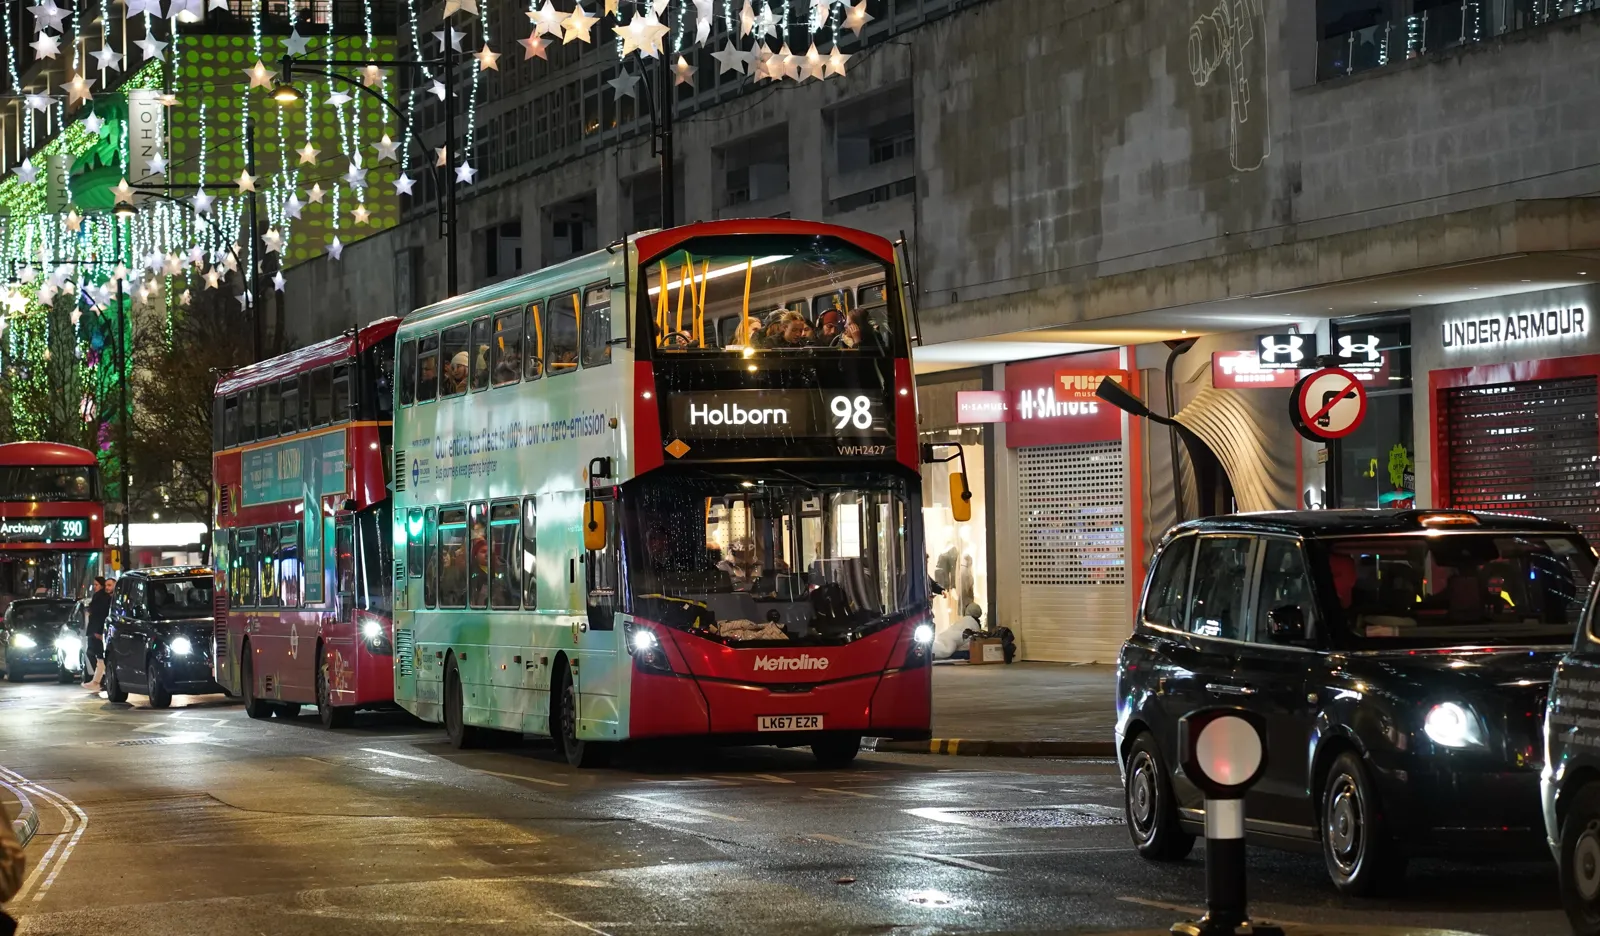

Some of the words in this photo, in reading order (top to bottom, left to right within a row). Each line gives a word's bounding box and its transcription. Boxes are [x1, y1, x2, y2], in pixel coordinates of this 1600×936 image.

[138, 102, 153, 157] JOHN
[1441, 317, 1501, 347] UNDER
[1504, 307, 1585, 341] ARMOUR
[690, 403, 788, 425] Holborn
[831, 395, 873, 430] 98
[435, 436, 447, 460] Our
[449, 433, 467, 457] entire
[468, 431, 480, 455] bus
[481, 428, 498, 452] fleet
[499, 424, 505, 449] is
[507, 420, 524, 449] 100%
[525, 419, 539, 446] low
[541, 422, 550, 443] or
[837, 445, 886, 456] VWH2427
[435, 465, 443, 479] Bus
[442, 463, 459, 481] journeys
[458, 462, 468, 478] keep
[468, 460, 482, 479] getting
[481, 457, 498, 476] brighter
[0, 522, 46, 539] Archway
[62, 521, 83, 537] 390
[753, 654, 829, 671] Metroline
[762, 717, 792, 729] LK67
[796, 716, 818, 728] EZR
